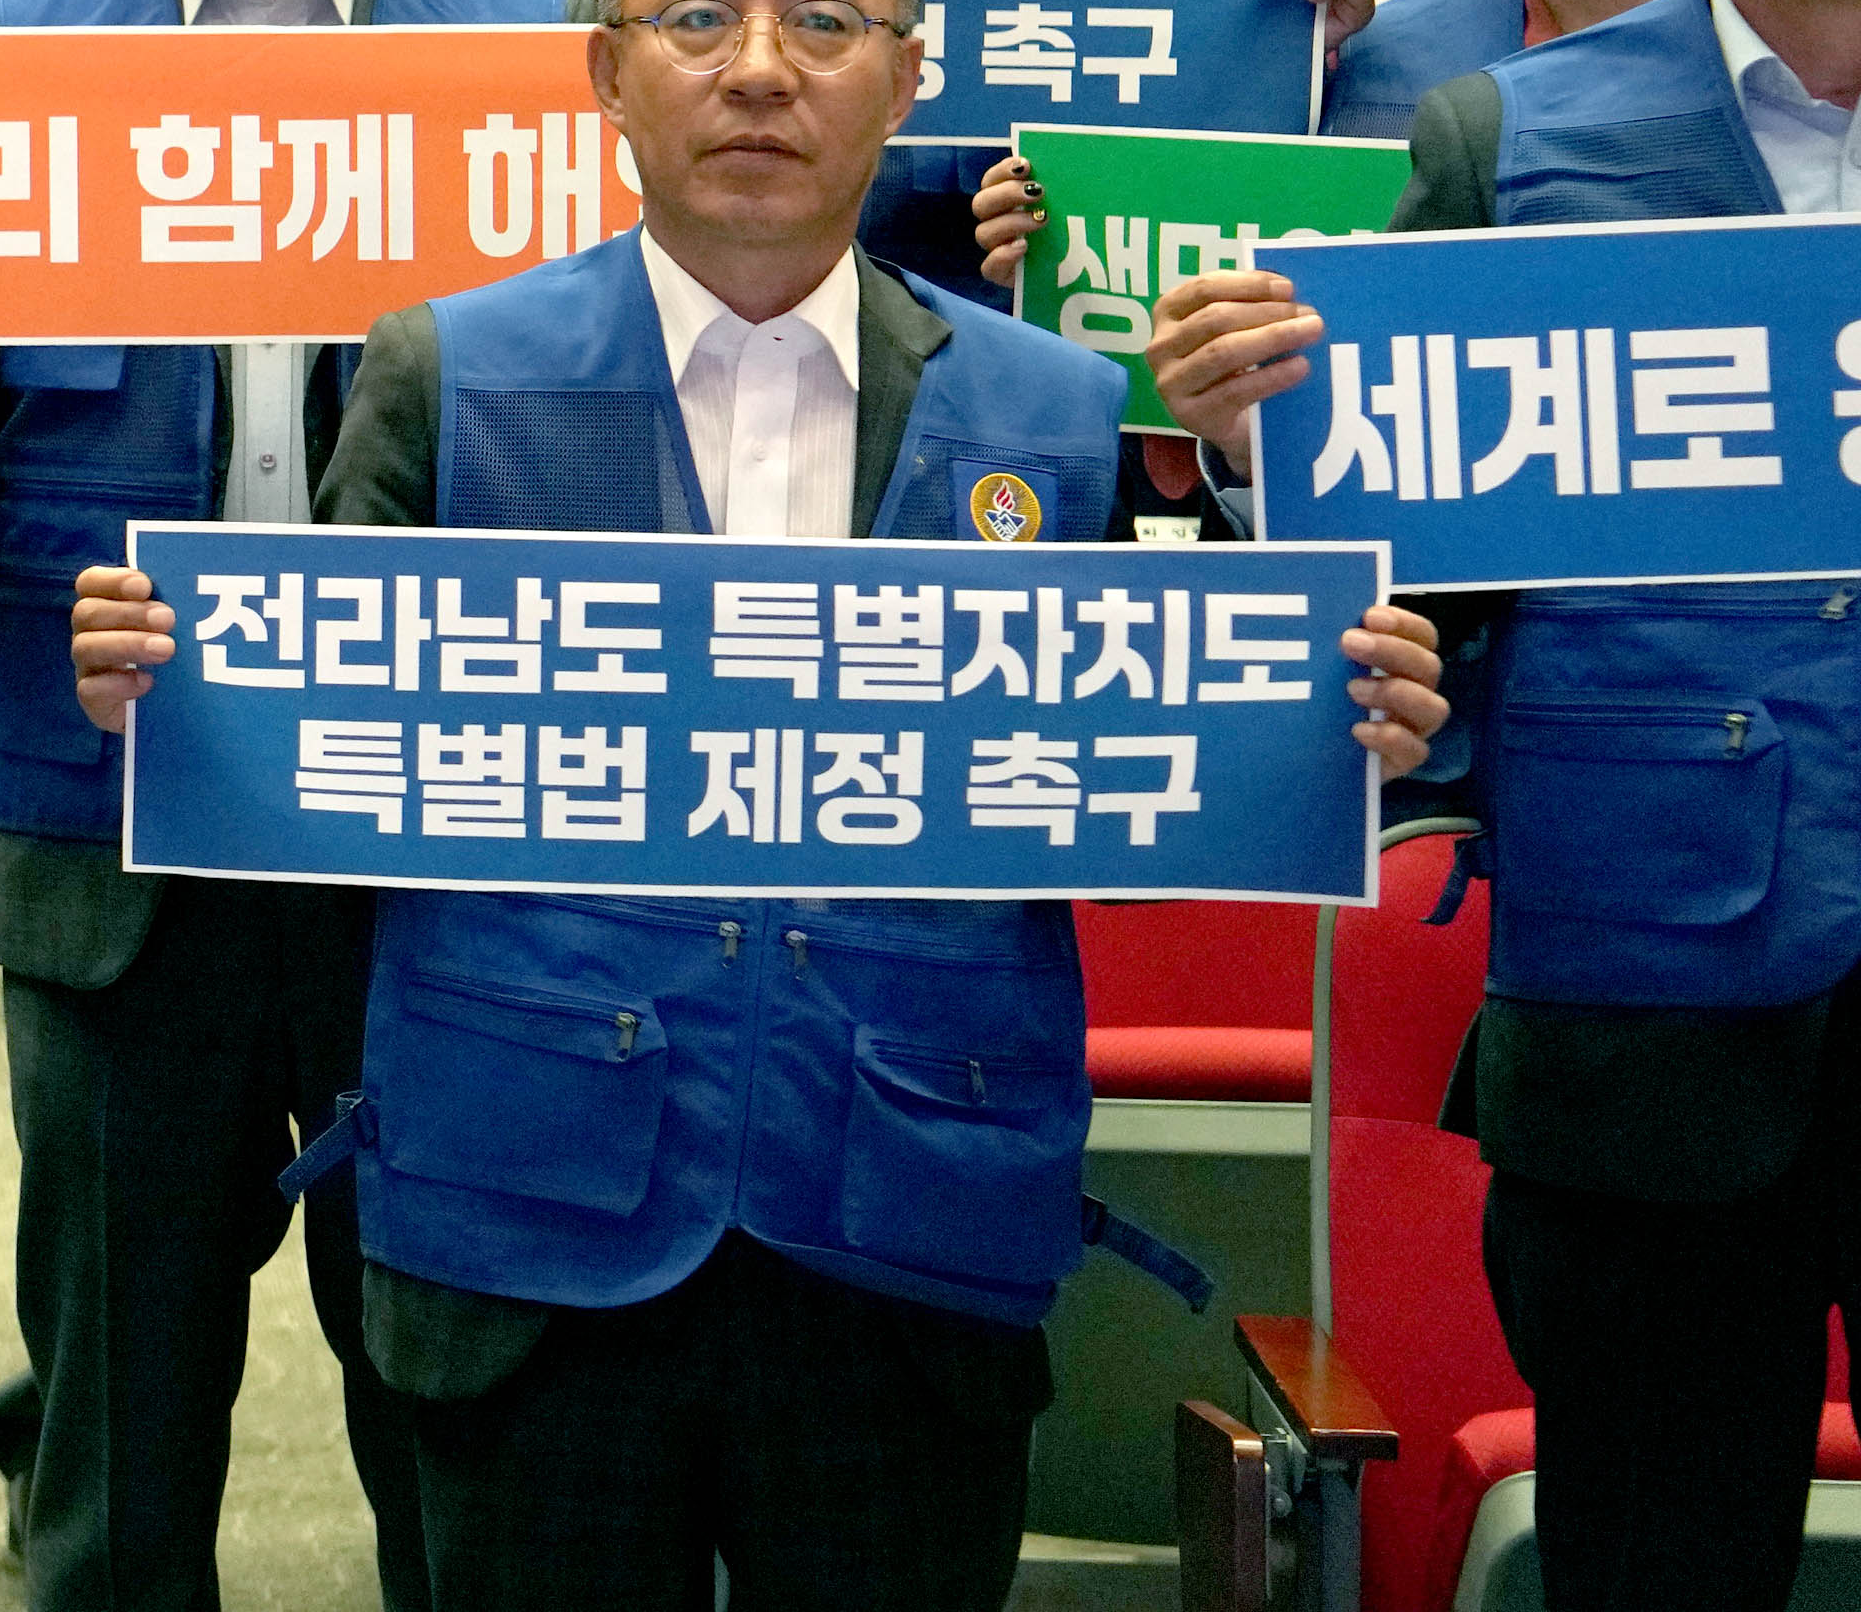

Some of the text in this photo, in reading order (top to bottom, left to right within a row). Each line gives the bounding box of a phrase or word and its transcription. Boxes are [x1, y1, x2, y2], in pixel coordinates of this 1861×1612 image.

[981, 2, 1178, 105] 촉구
[129, 113, 414, 263] 함께
[463, 112, 640, 261] 해
[1312, 326, 1783, 501] 세계로
[195, 572, 1313, 706] 전라남도 특별자치도
[294, 719, 1201, 847] 특별법 제정 촉구
